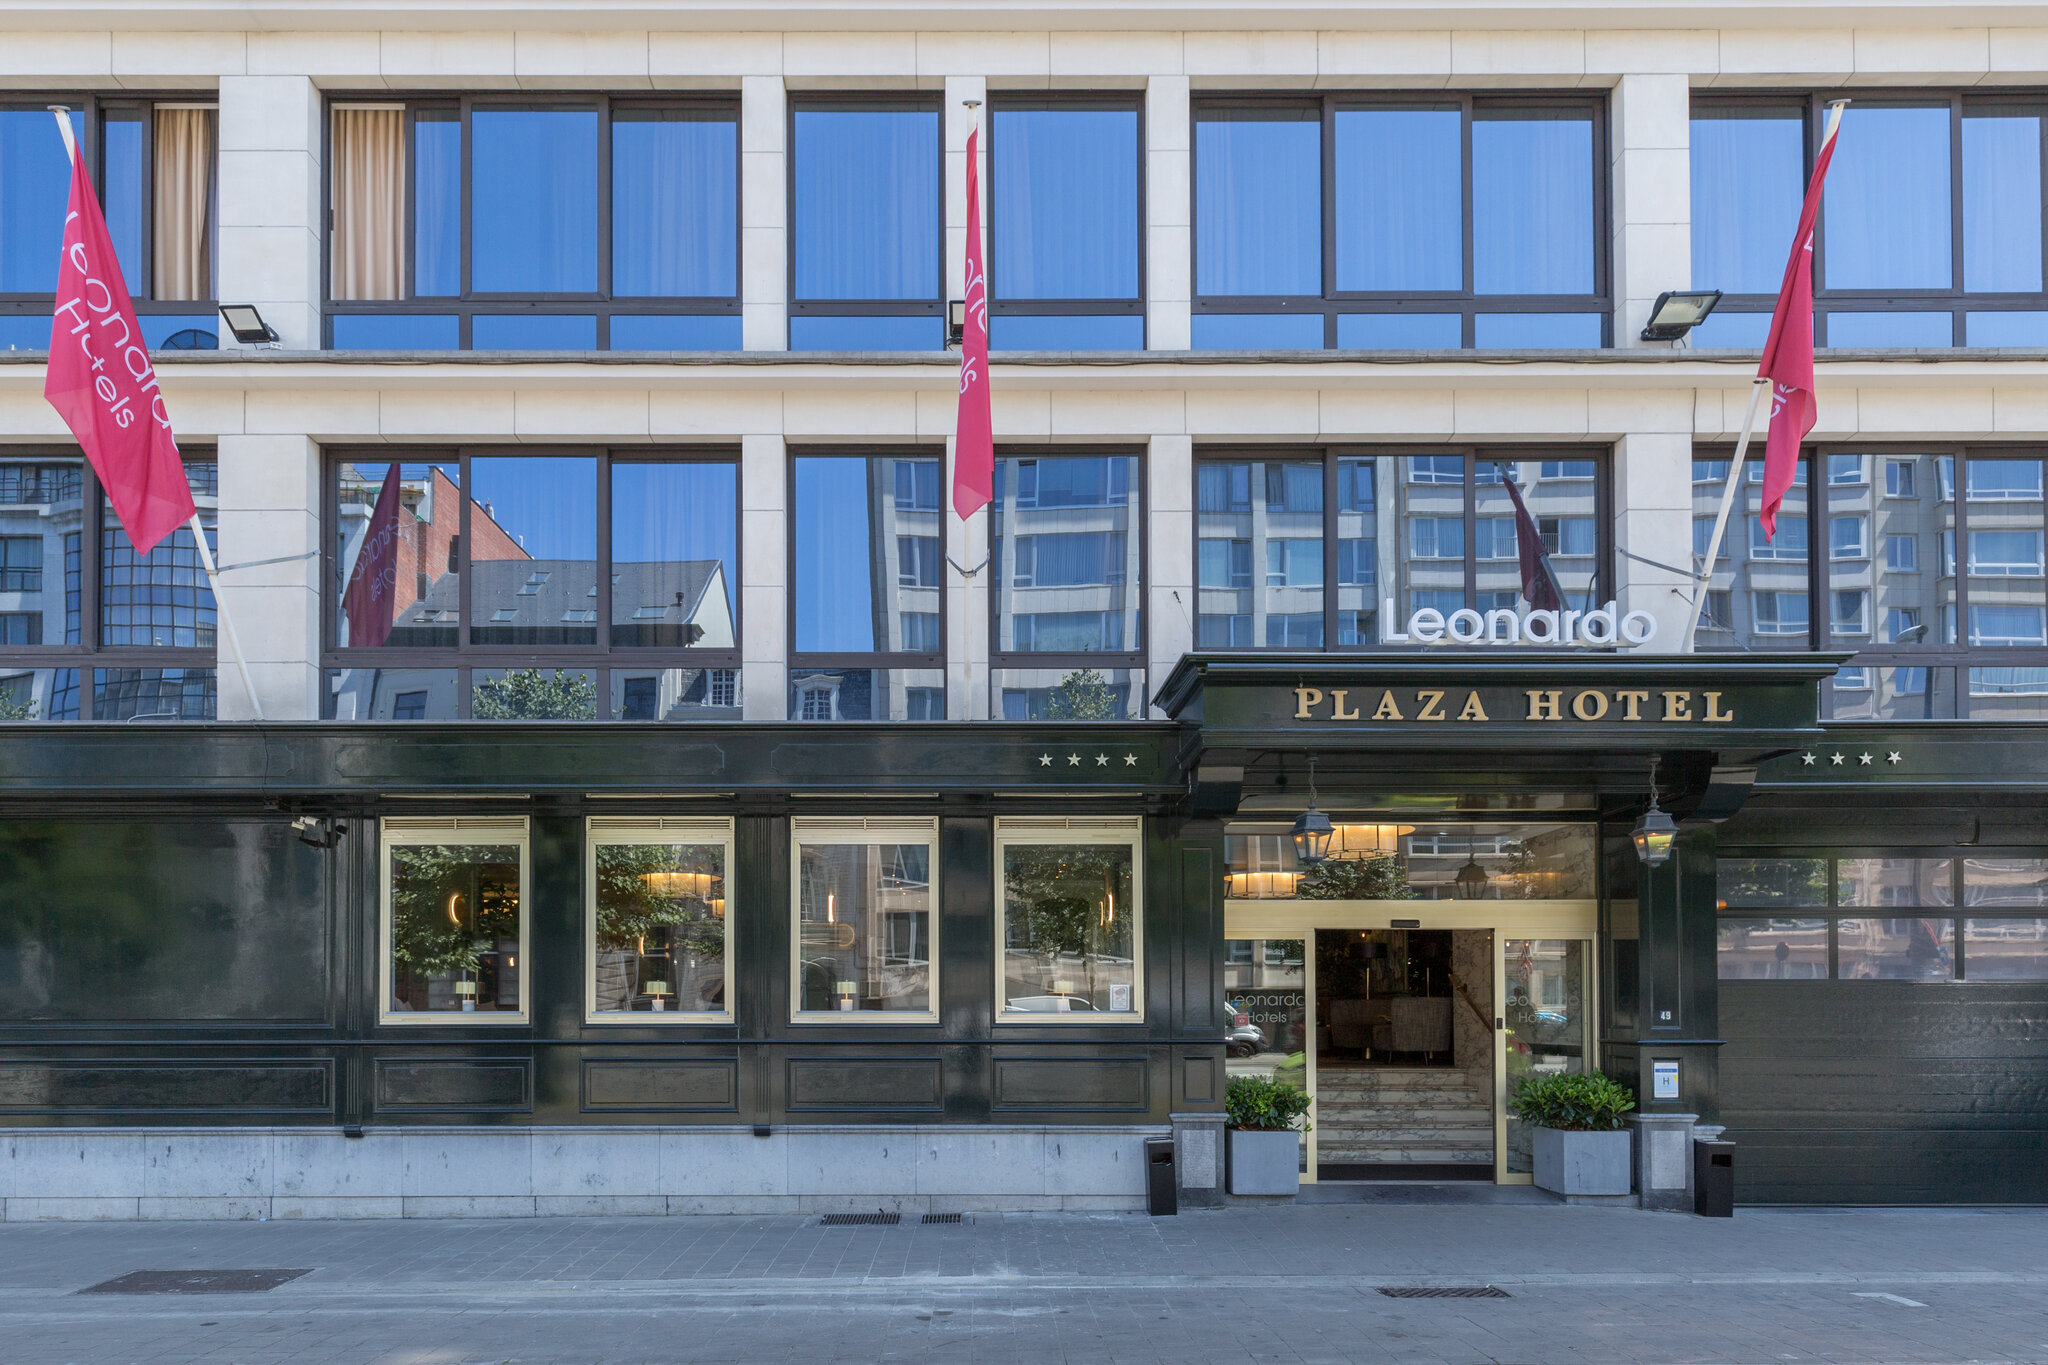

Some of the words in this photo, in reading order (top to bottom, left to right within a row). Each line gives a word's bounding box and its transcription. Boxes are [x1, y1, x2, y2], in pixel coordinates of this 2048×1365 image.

[1384, 598, 1658, 646] Leonardo
[1294, 687, 1489, 721] PLAZA
[1525, 690, 1734, 722] HOTEL
[1660, 1011, 1671, 1020] 49
